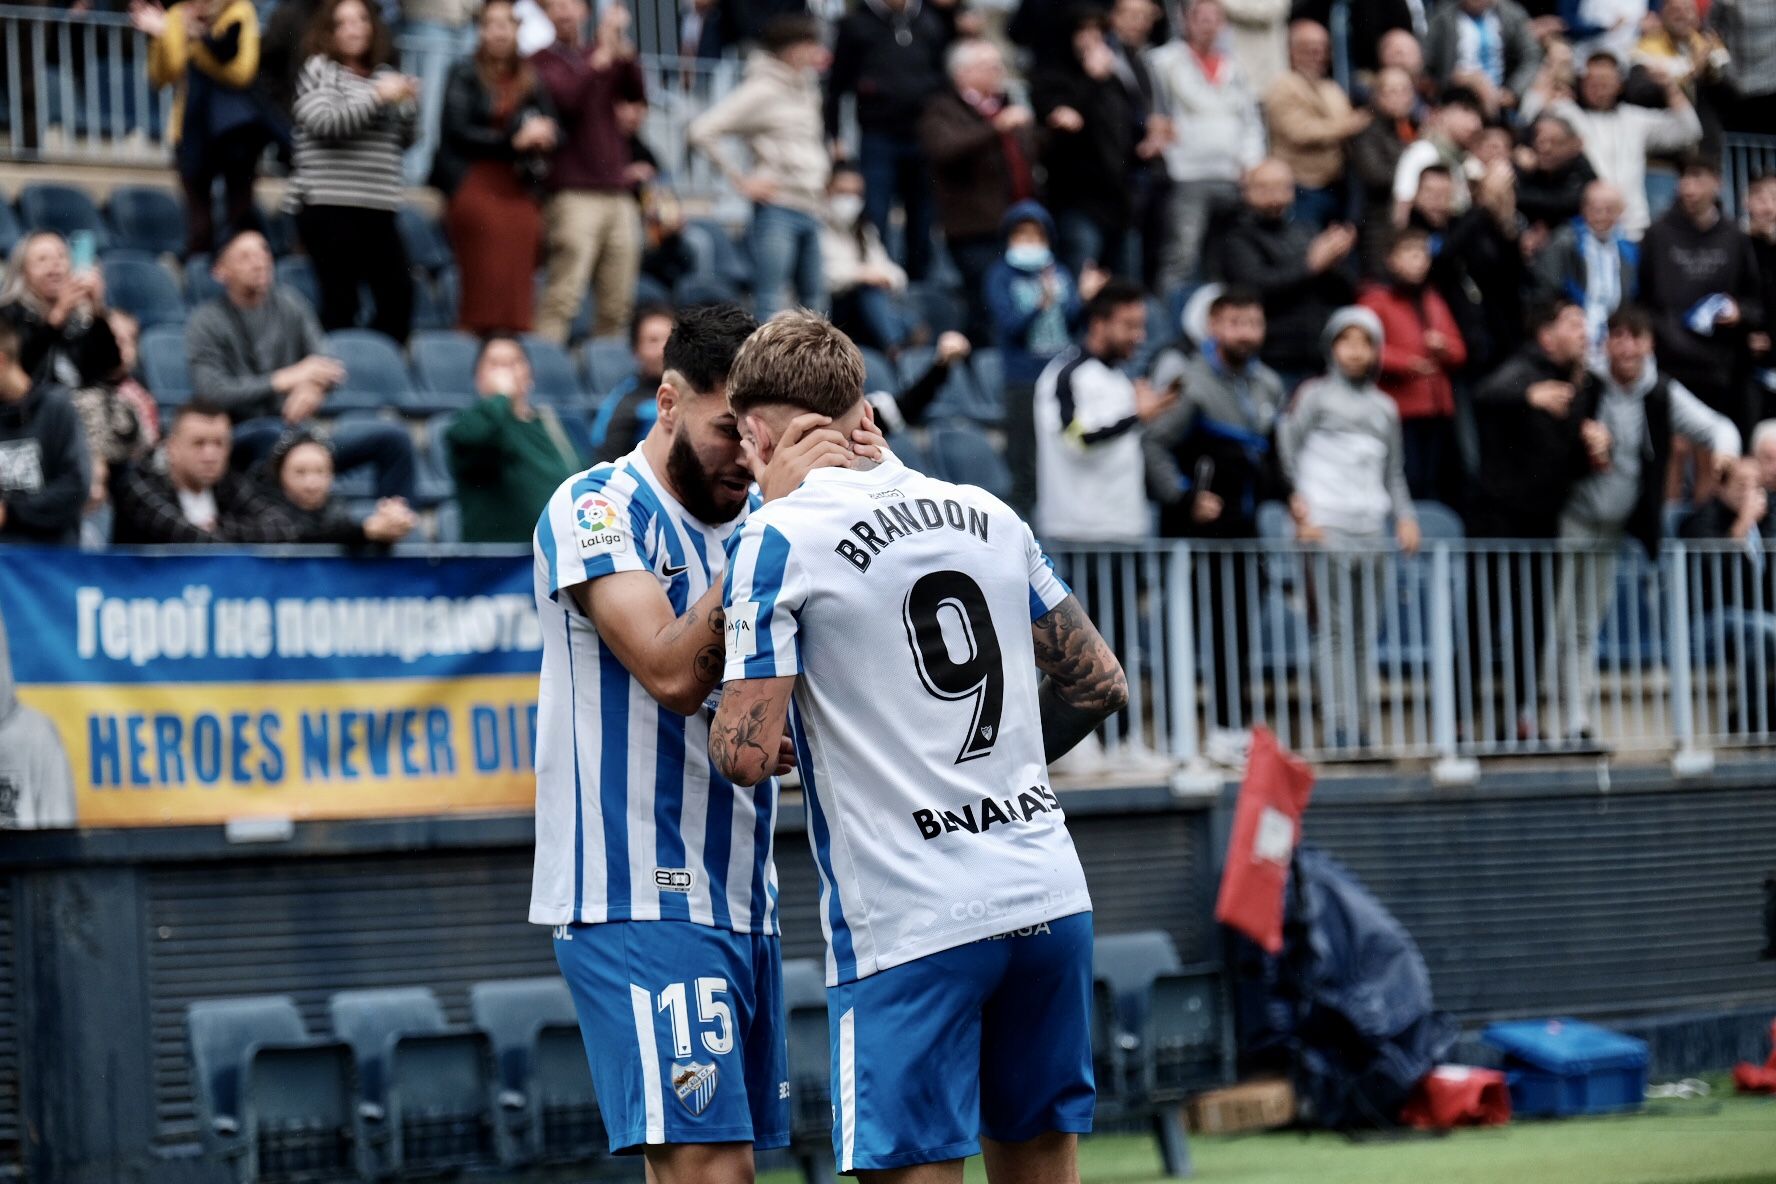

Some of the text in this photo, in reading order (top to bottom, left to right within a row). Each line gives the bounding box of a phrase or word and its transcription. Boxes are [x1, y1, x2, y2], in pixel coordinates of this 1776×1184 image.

[581, 533, 621, 548] LaLiga
[834, 498, 989, 574] BRANDON
[76, 584, 211, 665] Герої
[214, 597, 274, 658] не
[902, 569, 1004, 765] 9
[88, 712, 285, 788] HEROES
[302, 705, 455, 779] NEVER
[912, 784, 1061, 841] BNAAS
[657, 976, 734, 1059] 15
